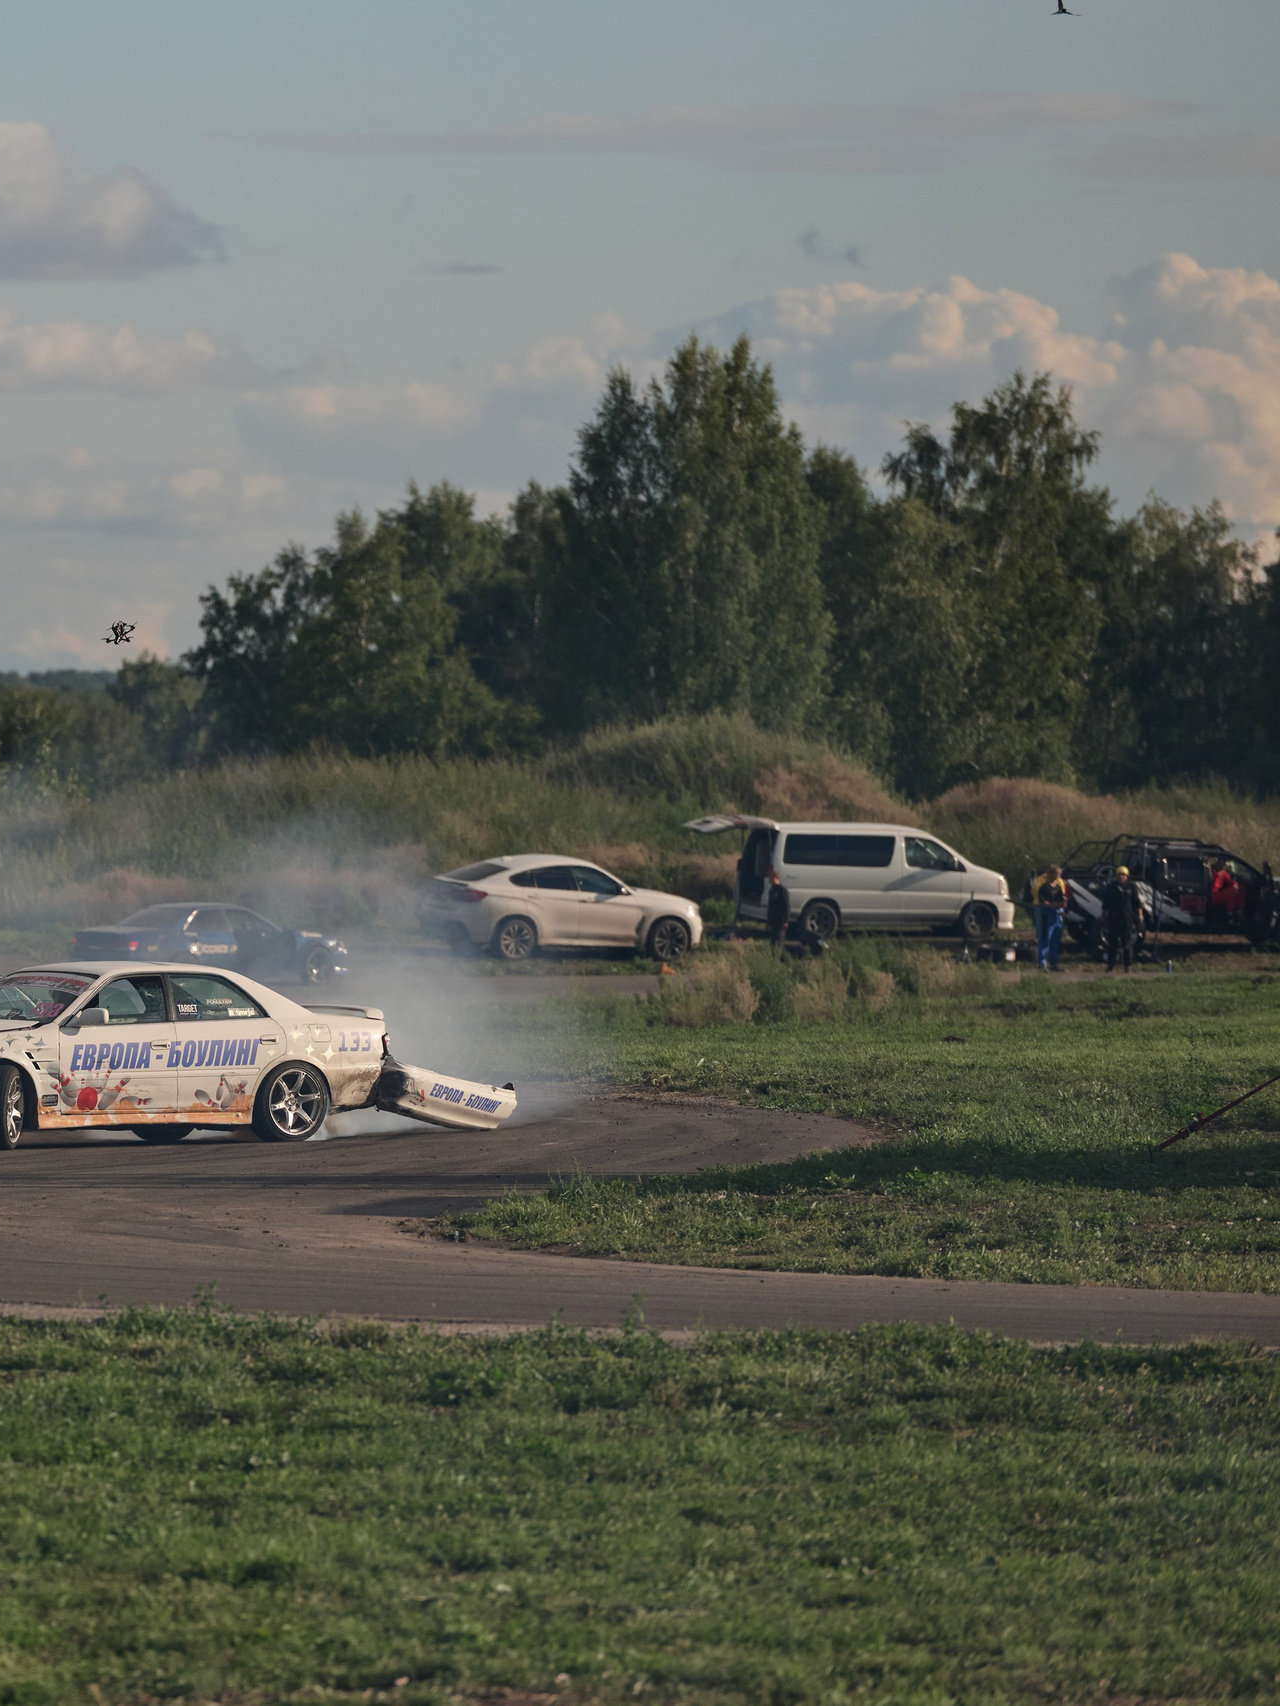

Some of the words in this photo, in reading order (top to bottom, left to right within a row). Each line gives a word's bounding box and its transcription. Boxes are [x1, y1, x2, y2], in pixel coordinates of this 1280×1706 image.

[176, 1004, 198, 1013] TARGET
[70, 1041, 151, 1071] ЕВРОПА
[166, 1038, 262, 1068] БОУЛИНГ
[338, 1031, 372, 1052] 133
[429, 1083, 464, 1104] ЕВРОПА
[465, 1094, 502, 1114] БОУЛИНГ
